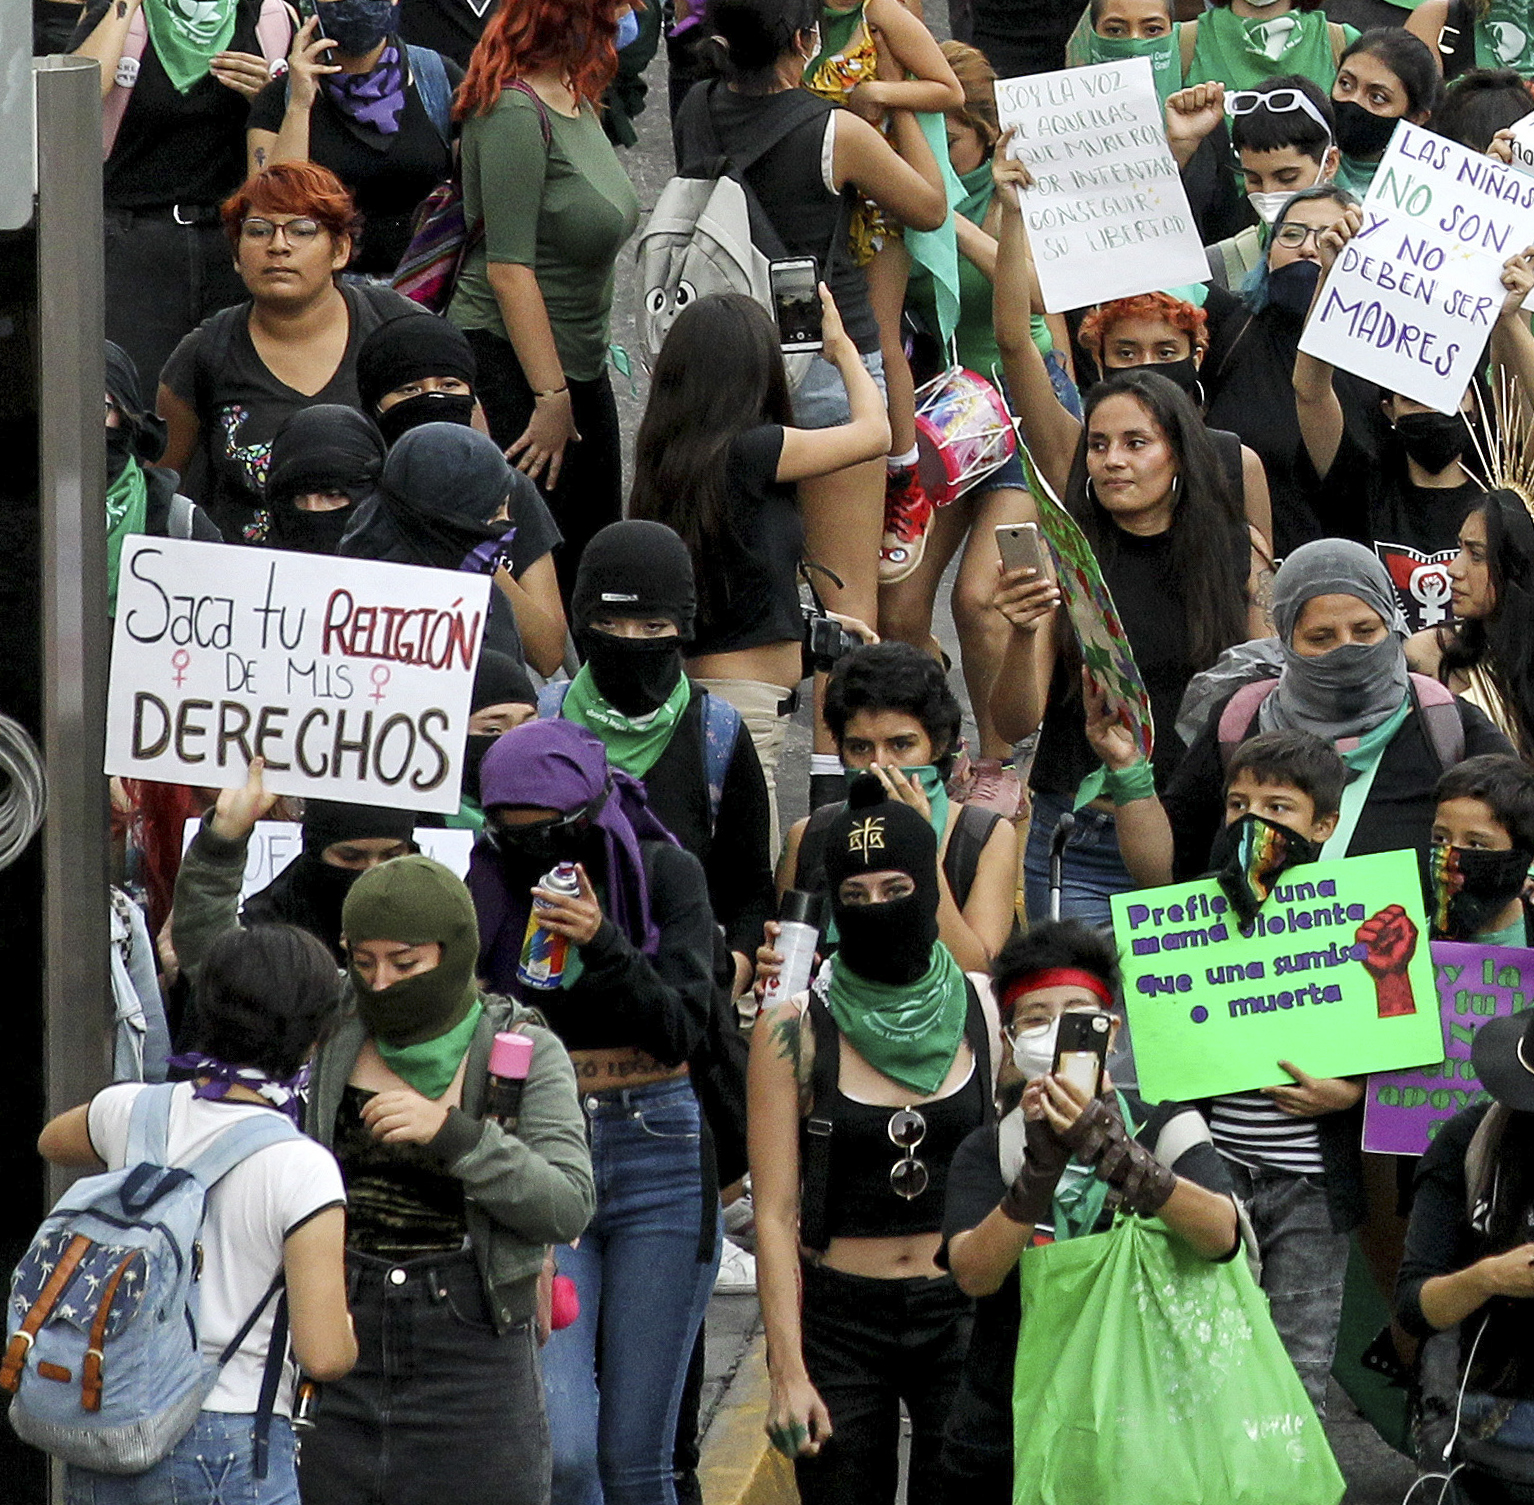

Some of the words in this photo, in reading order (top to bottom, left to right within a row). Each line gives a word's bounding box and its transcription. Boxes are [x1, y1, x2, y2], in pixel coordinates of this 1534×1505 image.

[1040, 103, 1138, 137] AQUELLAS
[1400, 127, 1448, 171] LAS
[1029, 194, 1149, 231] CONSEGUIR
[1042, 233, 1071, 257] SU
[1087, 213, 1186, 254] LIBERTAD
[1375, 172, 1432, 220] NO
[1440, 203, 1513, 254] SON
[1342, 246, 1436, 304] DEBEN
[1443, 284, 1493, 326] SER
[1320, 286, 1462, 377] MADRES
[125, 548, 234, 649] Saca
[253, 561, 306, 650] tu
[322, 589, 480, 671] RELIGIÓN
[130, 691, 450, 793] DERECHOS
[1136, 973, 1193, 998] que
[1206, 961, 1265, 985] una
[1273, 943, 1368, 977] sumisa
